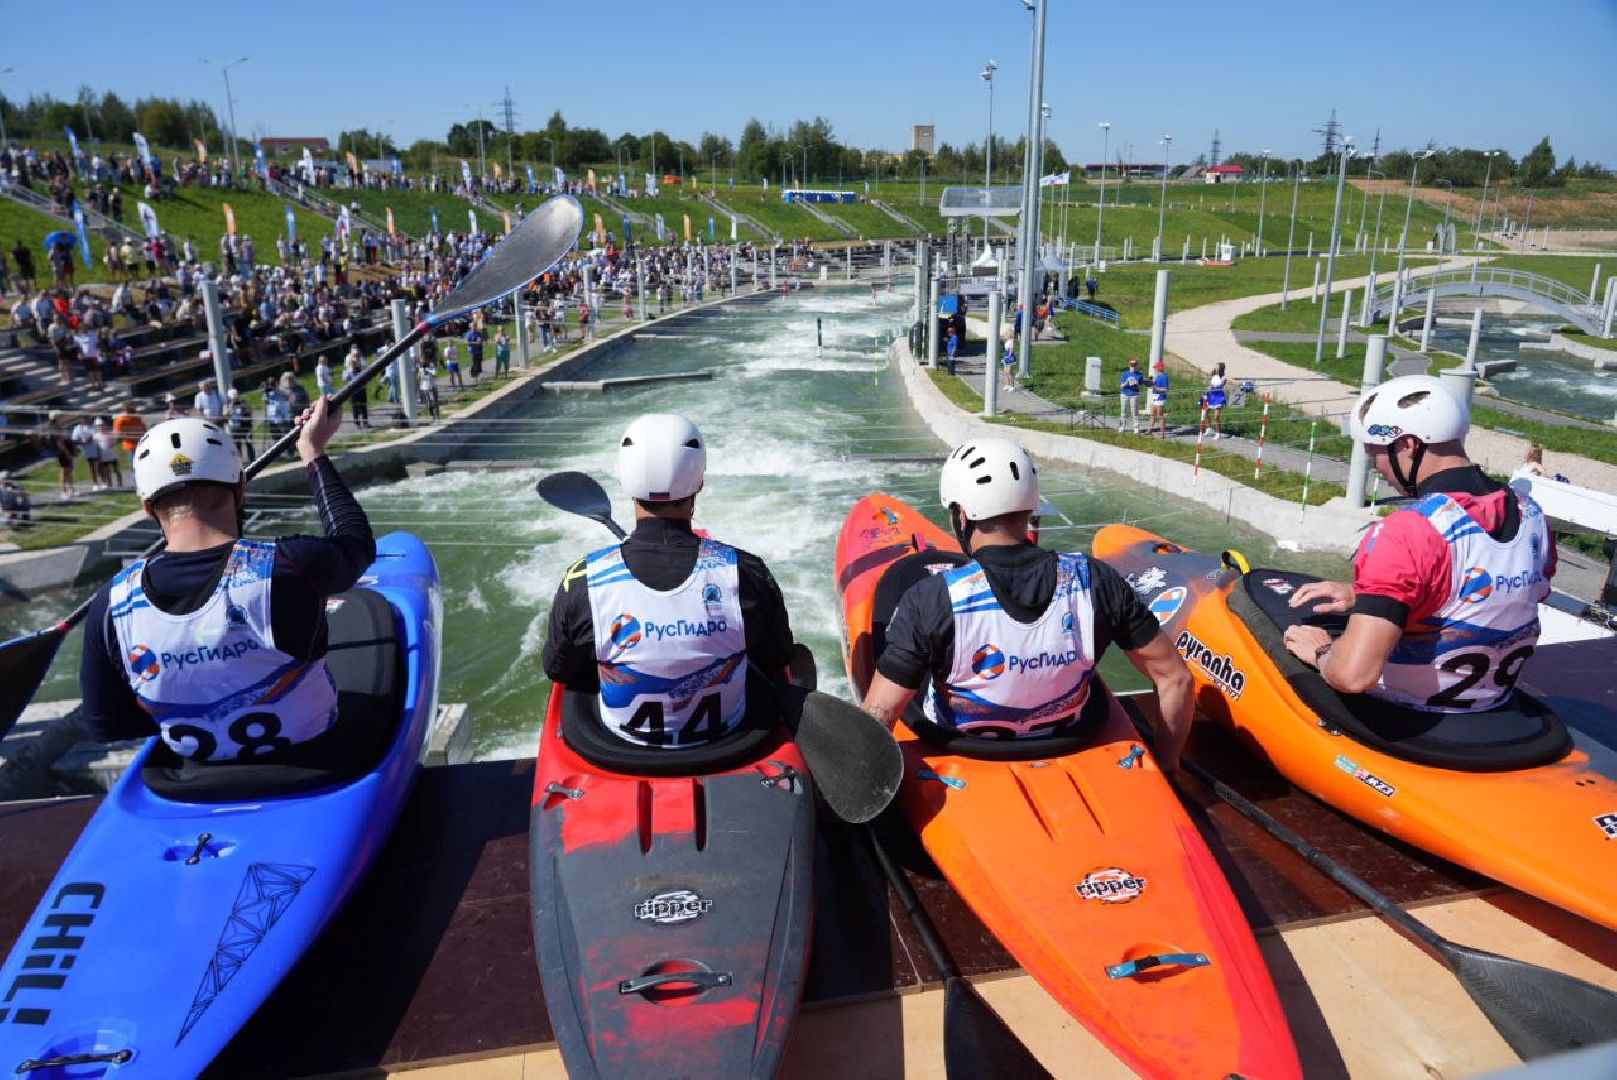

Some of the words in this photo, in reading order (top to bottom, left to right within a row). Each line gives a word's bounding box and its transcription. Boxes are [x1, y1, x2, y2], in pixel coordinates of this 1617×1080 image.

[645, 619, 728, 641] РусГидро
[1009, 650, 1078, 674] РусГидр
[1175, 630, 1245, 692] pyranha
[619, 692, 728, 745] 44
[1075, 876, 1147, 898] ripper
[634, 897, 713, 920] ripper
